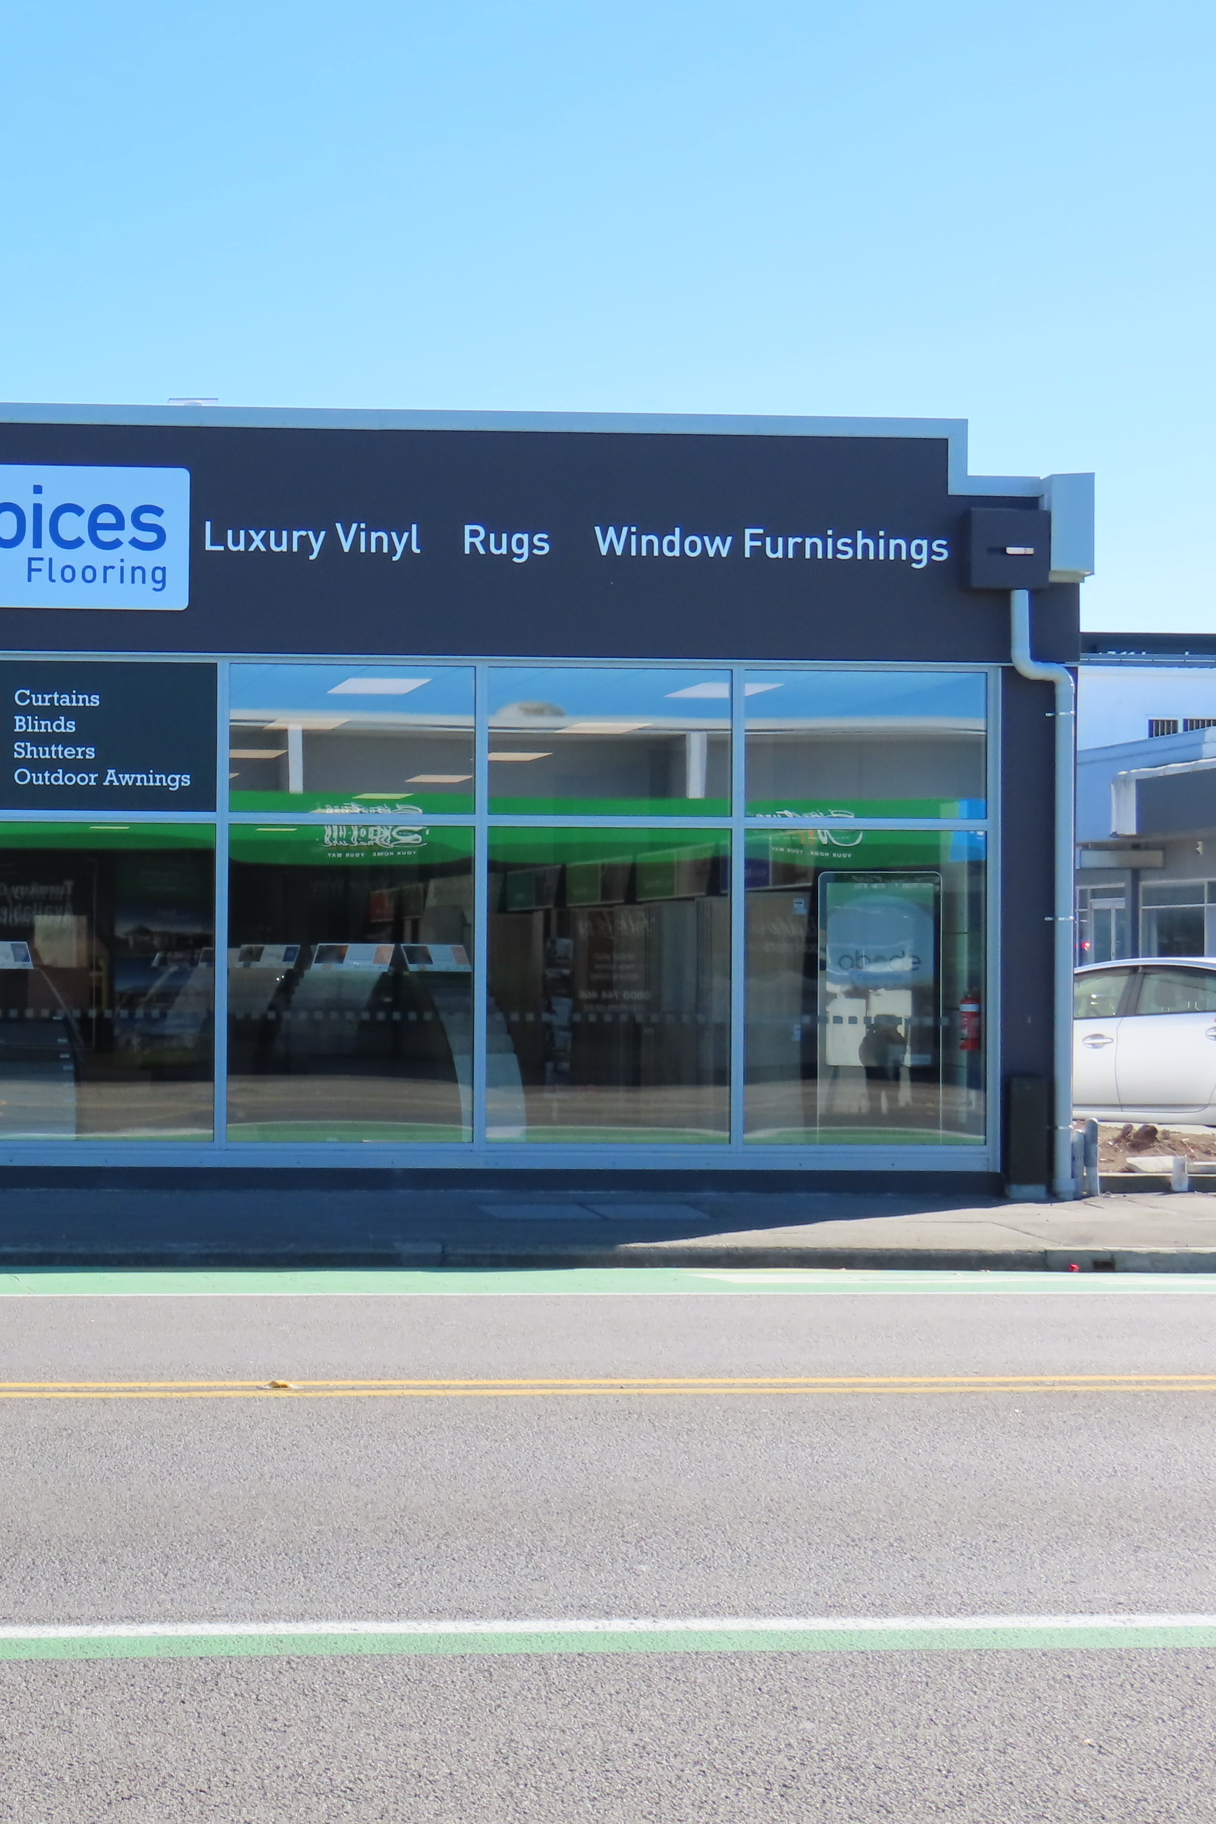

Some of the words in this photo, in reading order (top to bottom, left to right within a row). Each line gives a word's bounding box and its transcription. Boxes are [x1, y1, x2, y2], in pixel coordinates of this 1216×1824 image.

[204, 521, 326, 561] Luxury
[335, 521, 422, 561] Vinyl
[463, 523, 552, 564] Rugs
[594, 525, 733, 558] Window
[743, 527, 950, 570] Furnishings
[26, 557, 168, 593] Flooring
[14, 688, 101, 709] Curtains
[14, 714, 76, 734] Blinds
[13, 741, 96, 761] Shutters
[13, 768, 97, 787] Outdoor
[102, 768, 191, 790] Awnings
